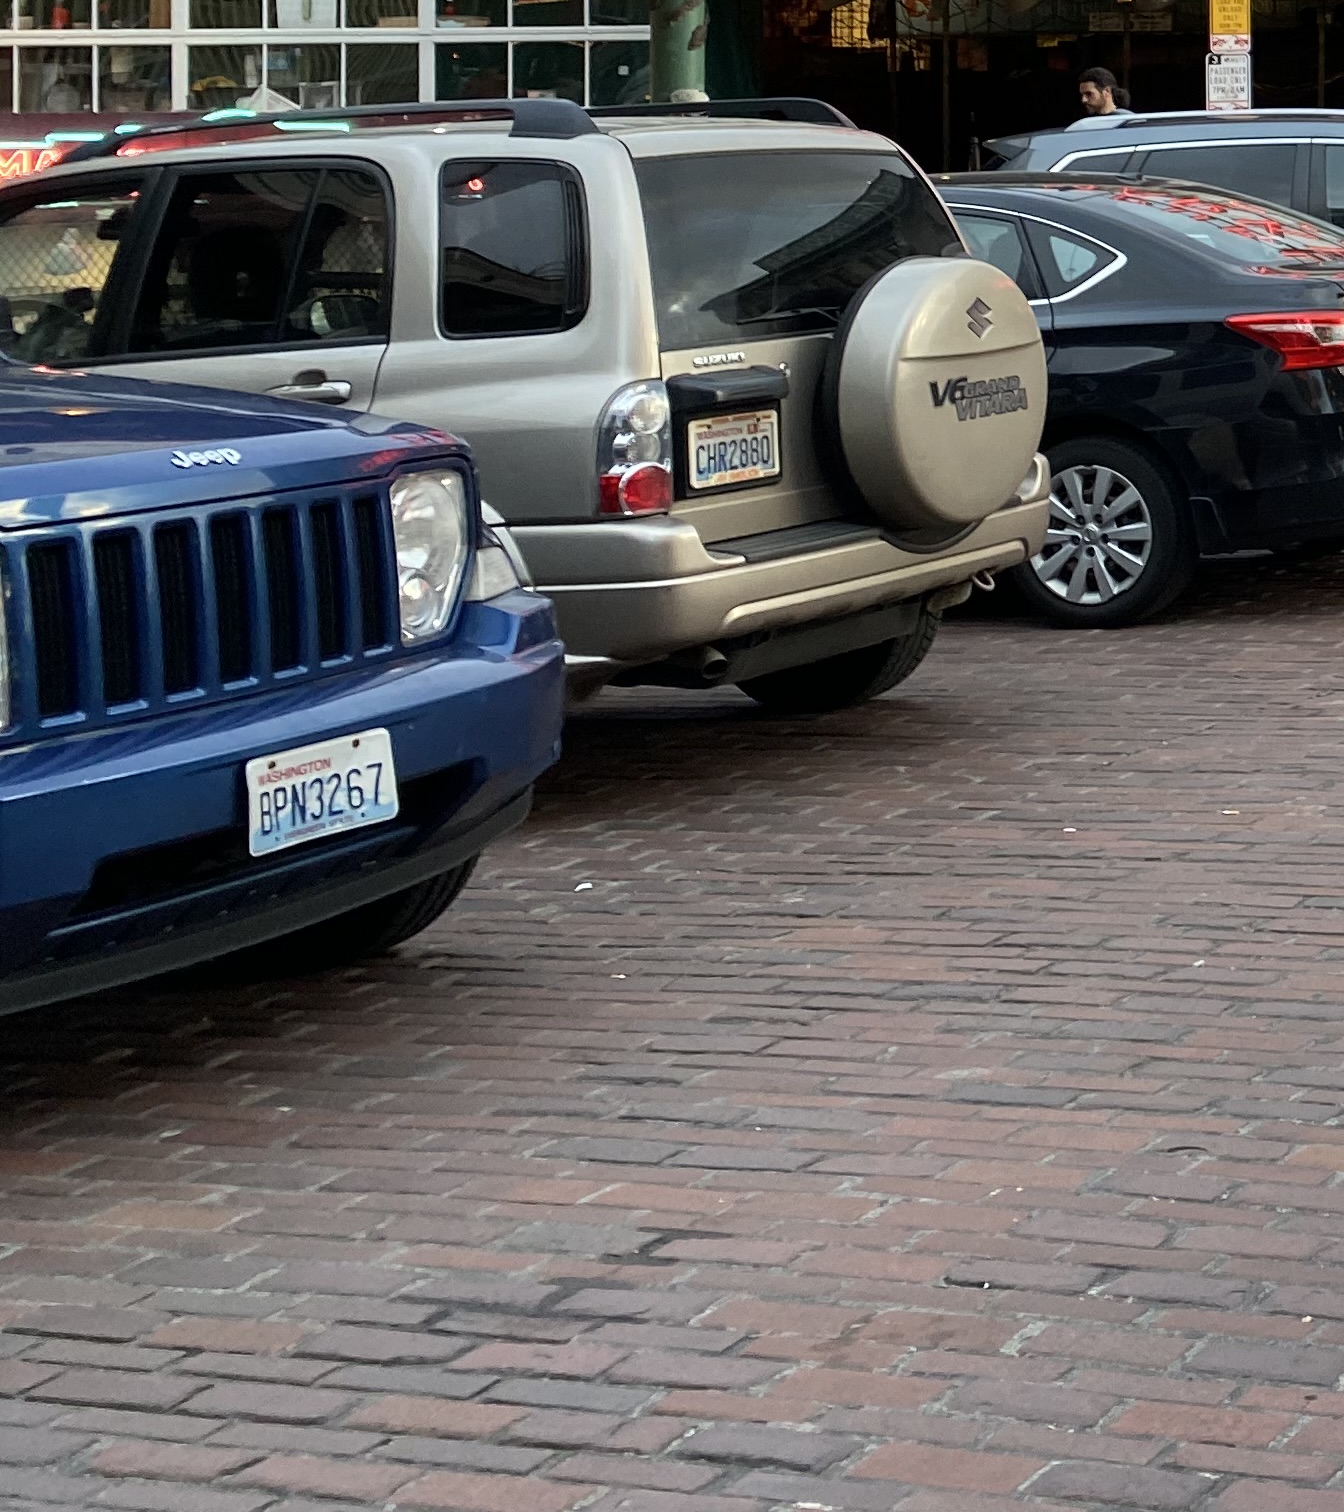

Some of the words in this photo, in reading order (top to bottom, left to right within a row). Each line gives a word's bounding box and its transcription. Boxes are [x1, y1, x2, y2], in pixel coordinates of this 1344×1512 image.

[1210, 67, 1246, 76] PASSENGER
[1210, 76, 1227, 85] LOAD
[1230, 76, 1246, 84] ONLY
[929, 375, 968, 407] V6
[963, 375, 1020, 398] GRAND
[955, 388, 1028, 421] VITARA
[170, 448, 242, 469] Jeep
[696, 435, 770, 475] CHR2880
[258, 757, 332, 786] WASHINGTON
[260, 762, 383, 836] BPN3267
